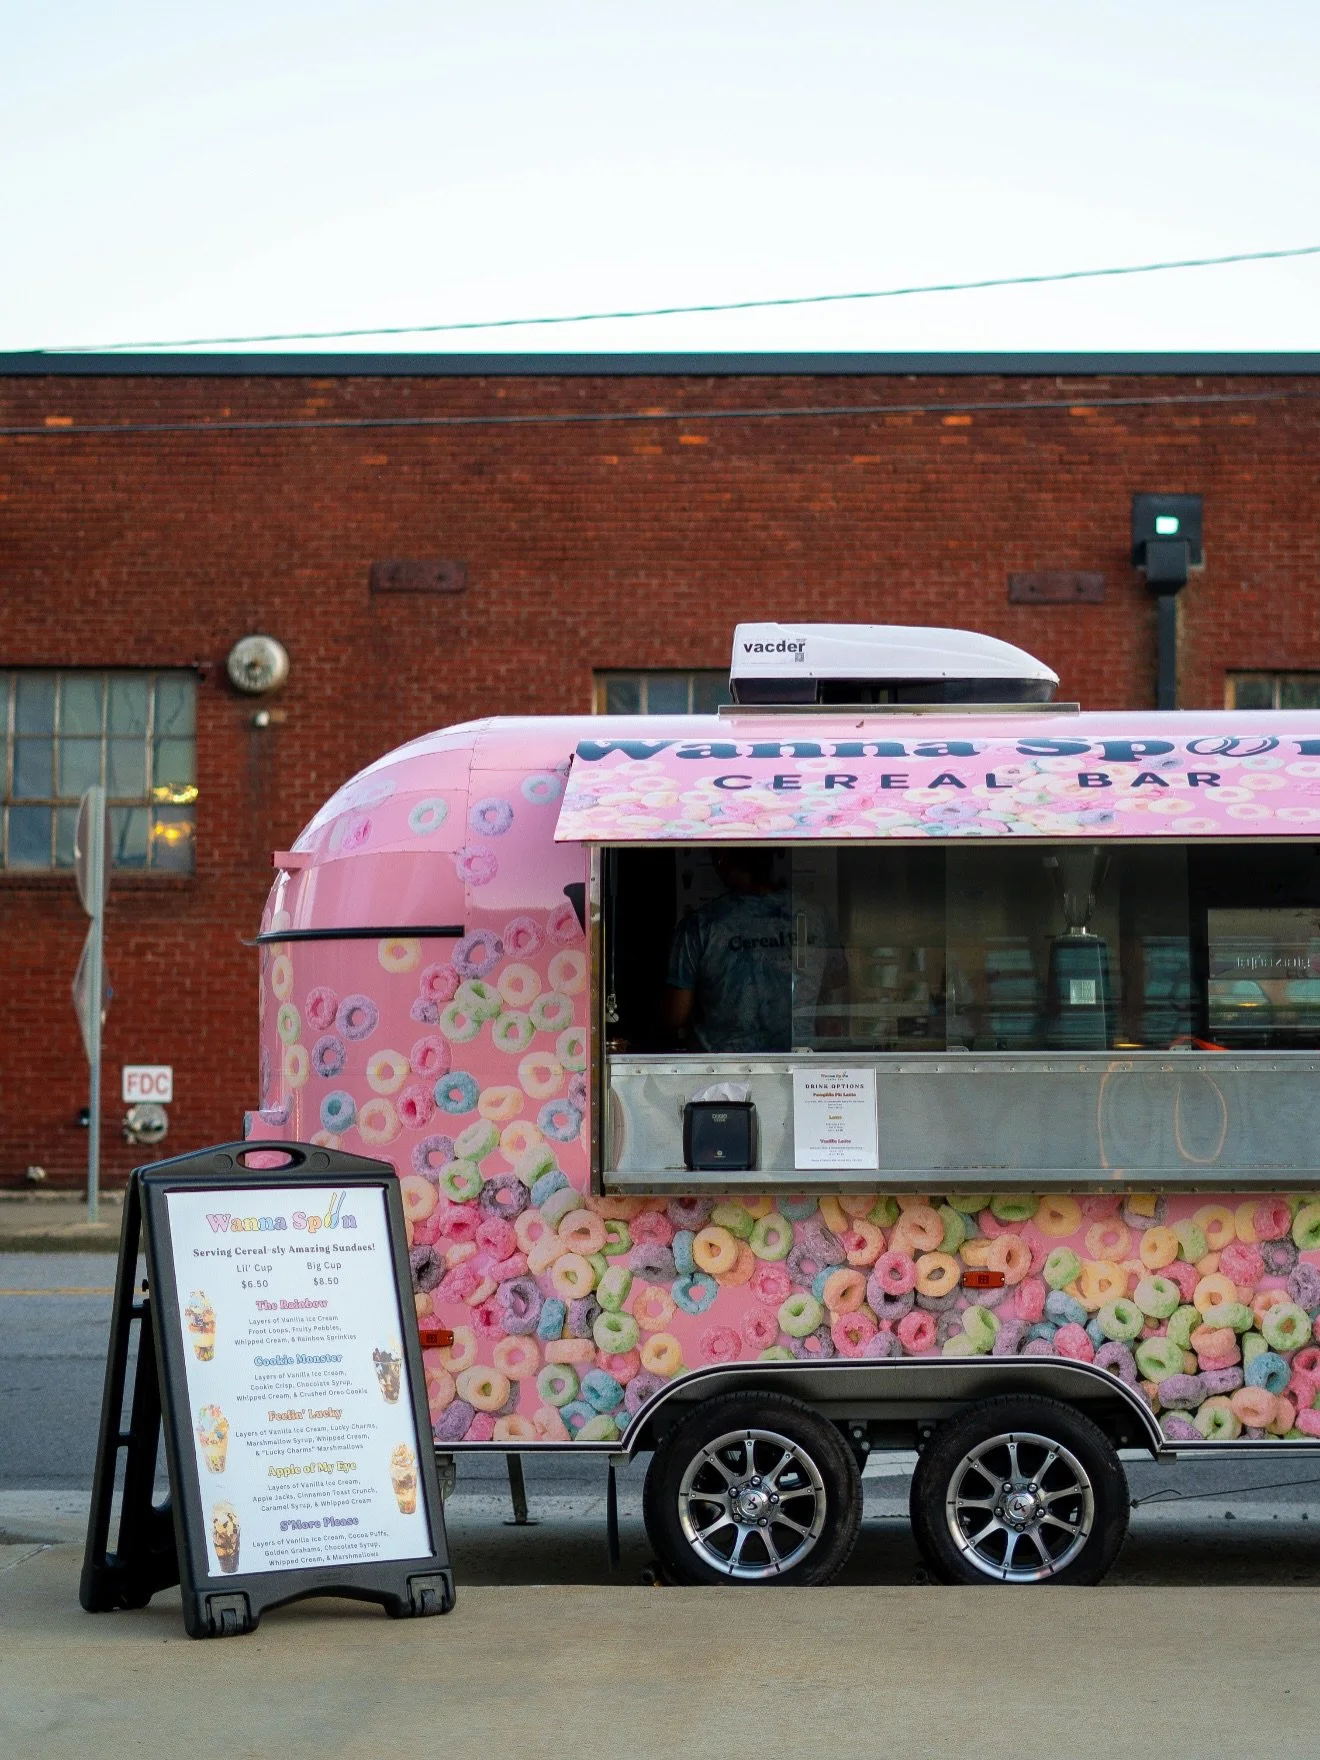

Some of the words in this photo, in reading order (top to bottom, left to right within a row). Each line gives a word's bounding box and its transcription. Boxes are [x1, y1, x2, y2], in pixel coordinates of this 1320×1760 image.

[744, 640, 806, 653] vacder
[576, 740, 981, 761] Wanna
[1016, 736, 1320, 762] Spoo
[714, 774, 1012, 789] CEREAL
[1078, 772, 1220, 788] BAR
[728, 932, 784, 950] Cereal
[127, 1072, 168, 1094] FDC
[206, 1214, 288, 1232] Wanna
[193, 1247, 232, 1258] Serving
[288, 1243, 330, 1254] Amazing
[332, 1242, 375, 1251] Sundaes!
[236, 1264, 250, 1272] Lil'
[254, 1263, 272, 1273] Cup
[306, 1261, 321, 1271] Big
[323, 1261, 341, 1270] Cup
[241, 1279, 268, 1289] $6.50
[313, 1276, 338, 1286] $8.50
[255, 1299, 278, 1310] The
[279, 1297, 328, 1309] Rainbow
[234, 1337, 263, 1346] Whipped
[253, 1354, 294, 1367] Cookie
[295, 1353, 343, 1364] Monster
[236, 1393, 266, 1402] Whipped
[267, 1408, 305, 1421] Feelin'
[307, 1406, 342, 1419] Lucky
[246, 1438, 291, 1446] Marshmallow
[315, 1433, 344, 1442] Whipped
[316, 1443, 363, 1451] Marshmallows
[267, 1463, 301, 1478] Apple
[302, 1462, 315, 1473] of
[317, 1461, 334, 1474] My
[336, 1460, 356, 1473] Eye
[261, 1503, 289, 1511] Caramel
[320, 1499, 349, 1507] Whipped
[322, 1515, 359, 1527] Please
[268, 1557, 298, 1566] Whipped
[332, 1551, 378, 1560] Marshmallows
